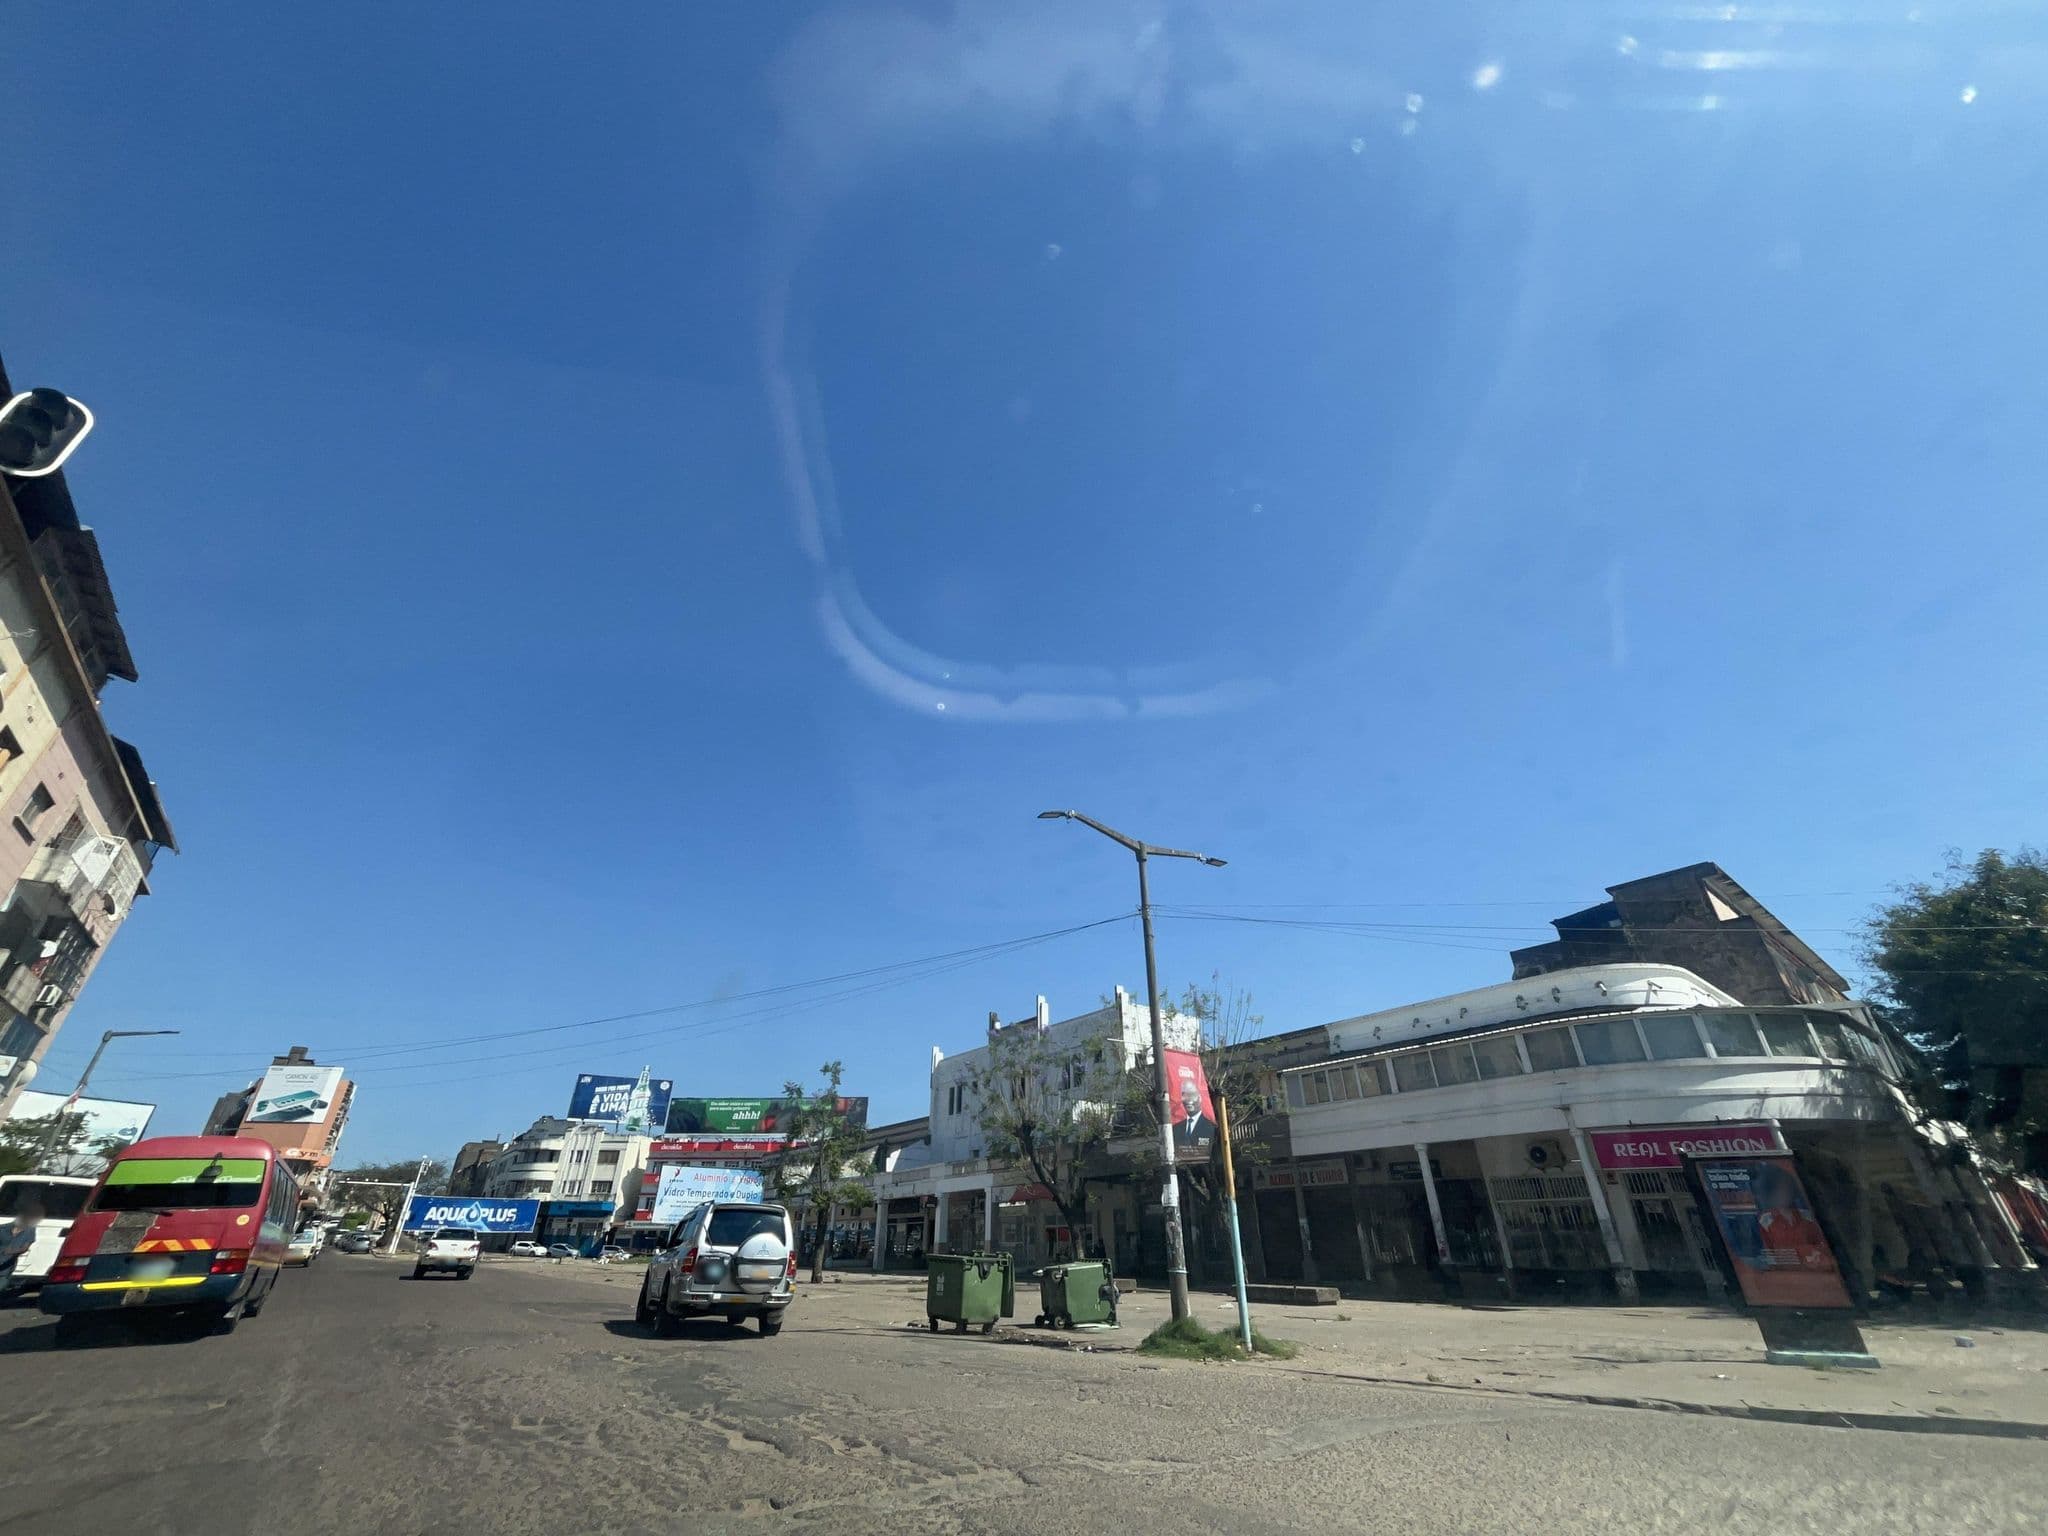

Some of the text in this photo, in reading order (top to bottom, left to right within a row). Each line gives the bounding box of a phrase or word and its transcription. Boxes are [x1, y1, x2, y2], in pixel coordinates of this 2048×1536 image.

[603, 1091, 629, 1103] VIDA
[732, 1110, 760, 1120] ahhh!
[1613, 1137, 1768, 1158] REAL FASHION
[663, 1186, 684, 1197] Vidro
[687, 1187, 729, 1199] Temperado
[736, 1190, 759, 1200] Duplo
[480, 1207, 518, 1222] PLUS
